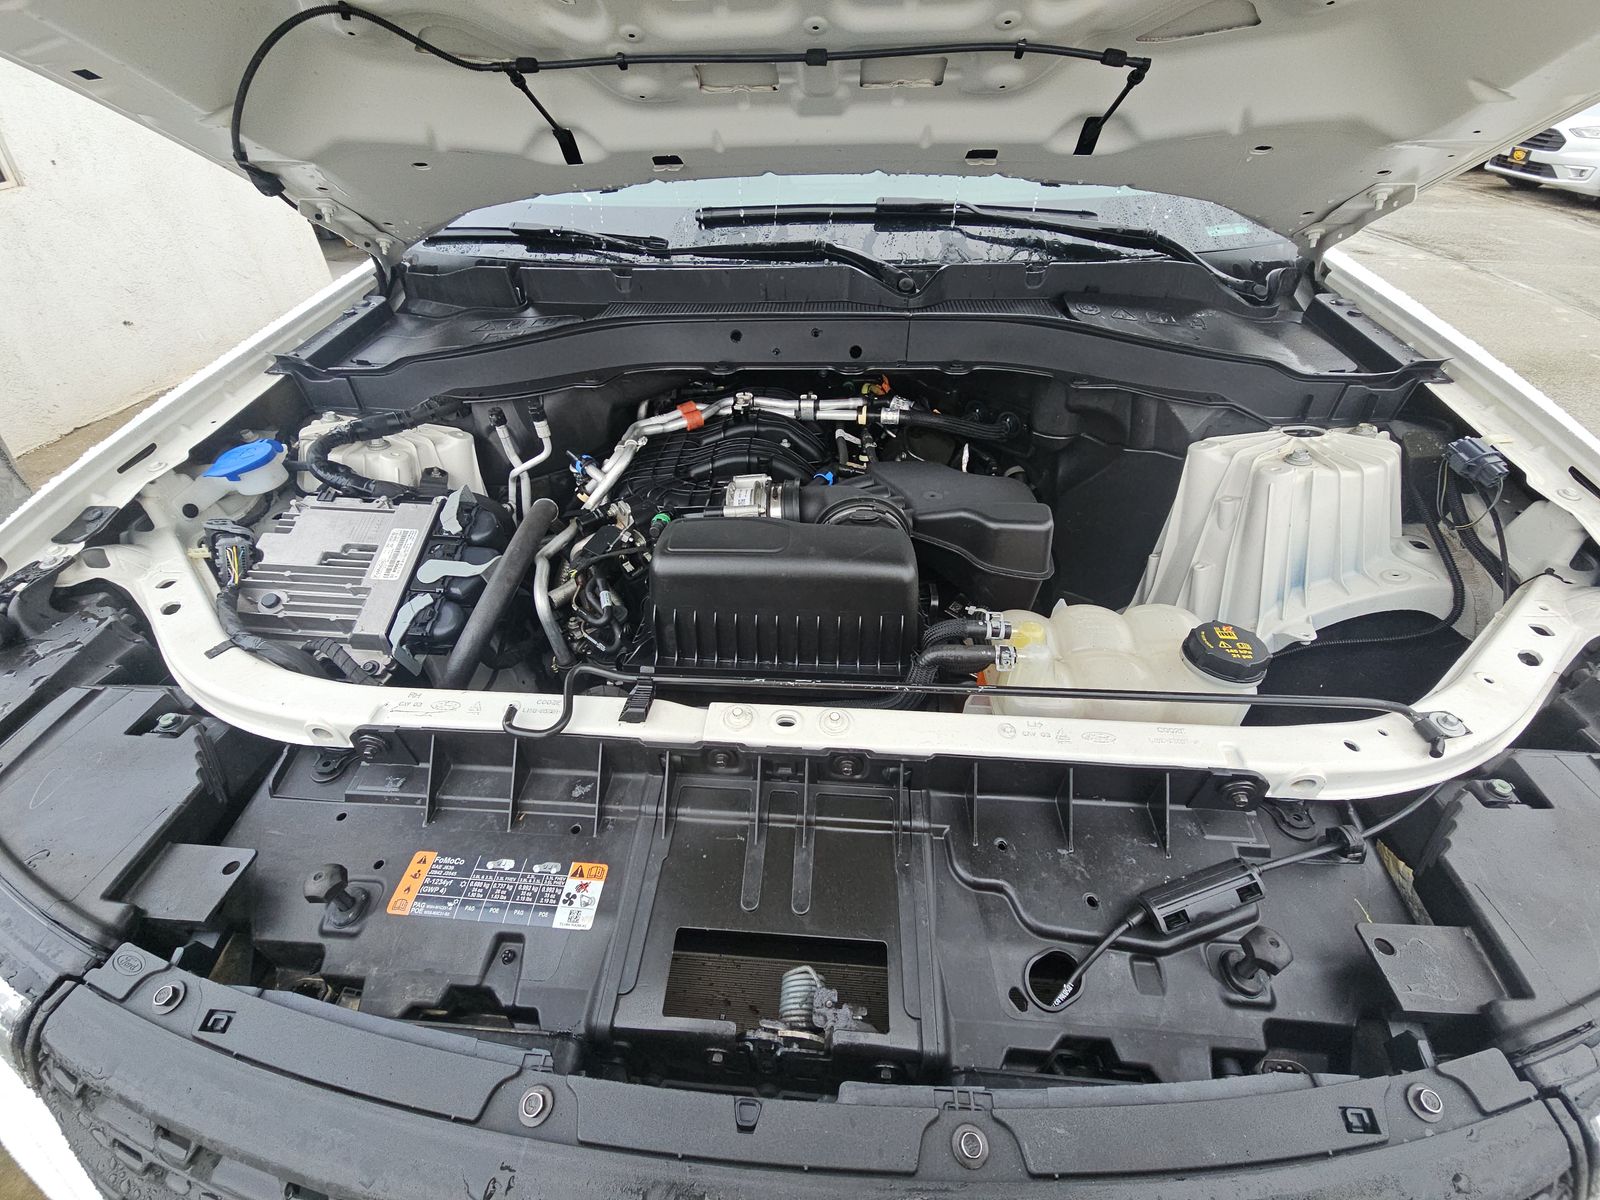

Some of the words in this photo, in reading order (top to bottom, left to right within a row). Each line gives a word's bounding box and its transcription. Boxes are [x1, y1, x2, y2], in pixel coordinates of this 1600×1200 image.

[434, 856, 465, 865] FoMoCo
[423, 877, 454, 887] R-1234yf
[483, 881, 490, 889] kg
[420, 886, 440, 894] (GWP
[439, 887, 447, 895] 4)
[506, 883, 513, 891] kg
[555, 887, 563, 895] kg
[412, 901, 426, 909] PAG
